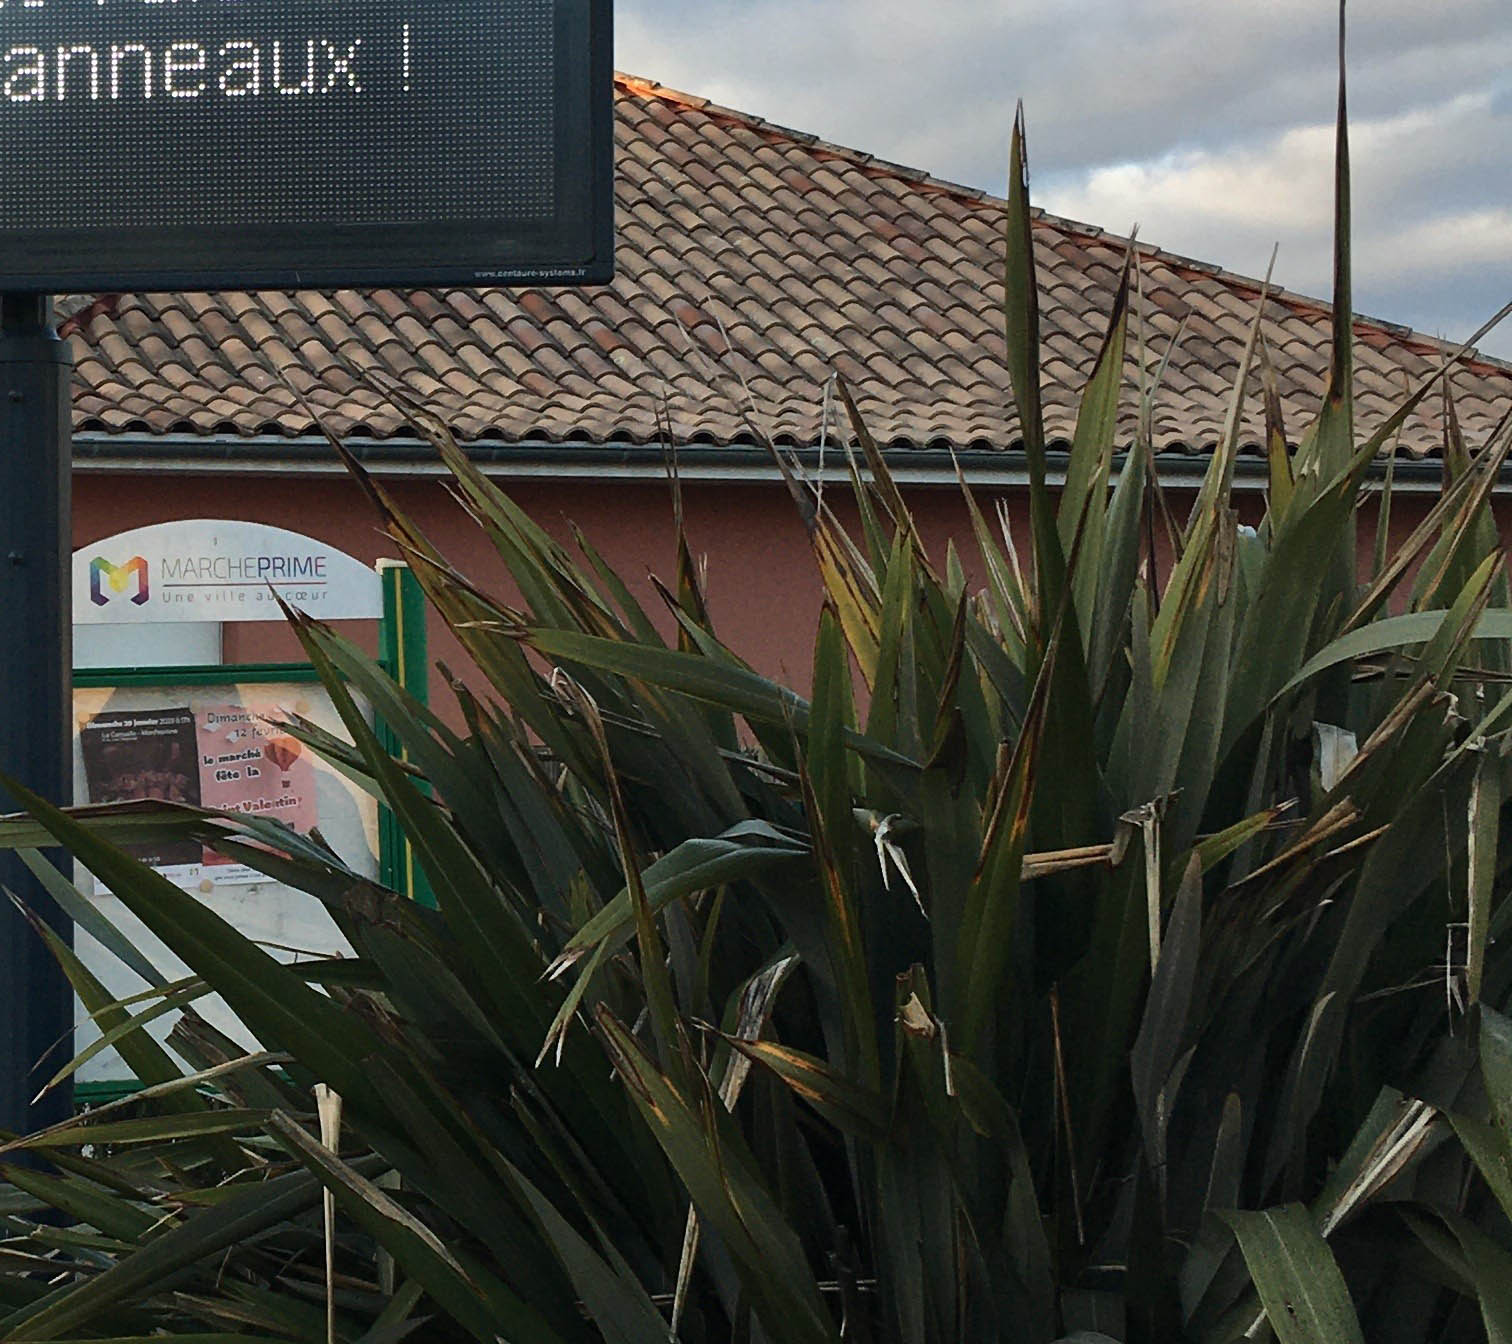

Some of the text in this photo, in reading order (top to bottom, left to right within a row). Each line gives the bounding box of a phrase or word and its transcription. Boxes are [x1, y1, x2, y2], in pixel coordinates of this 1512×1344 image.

[401, 24, 410, 92] !
[161, 556, 328, 579] MARCHEPRIME
[162, 592, 194, 603] Une
[206, 591, 245, 602] ville
[234, 729, 247, 737] 12
[247, 766, 260, 777] la
